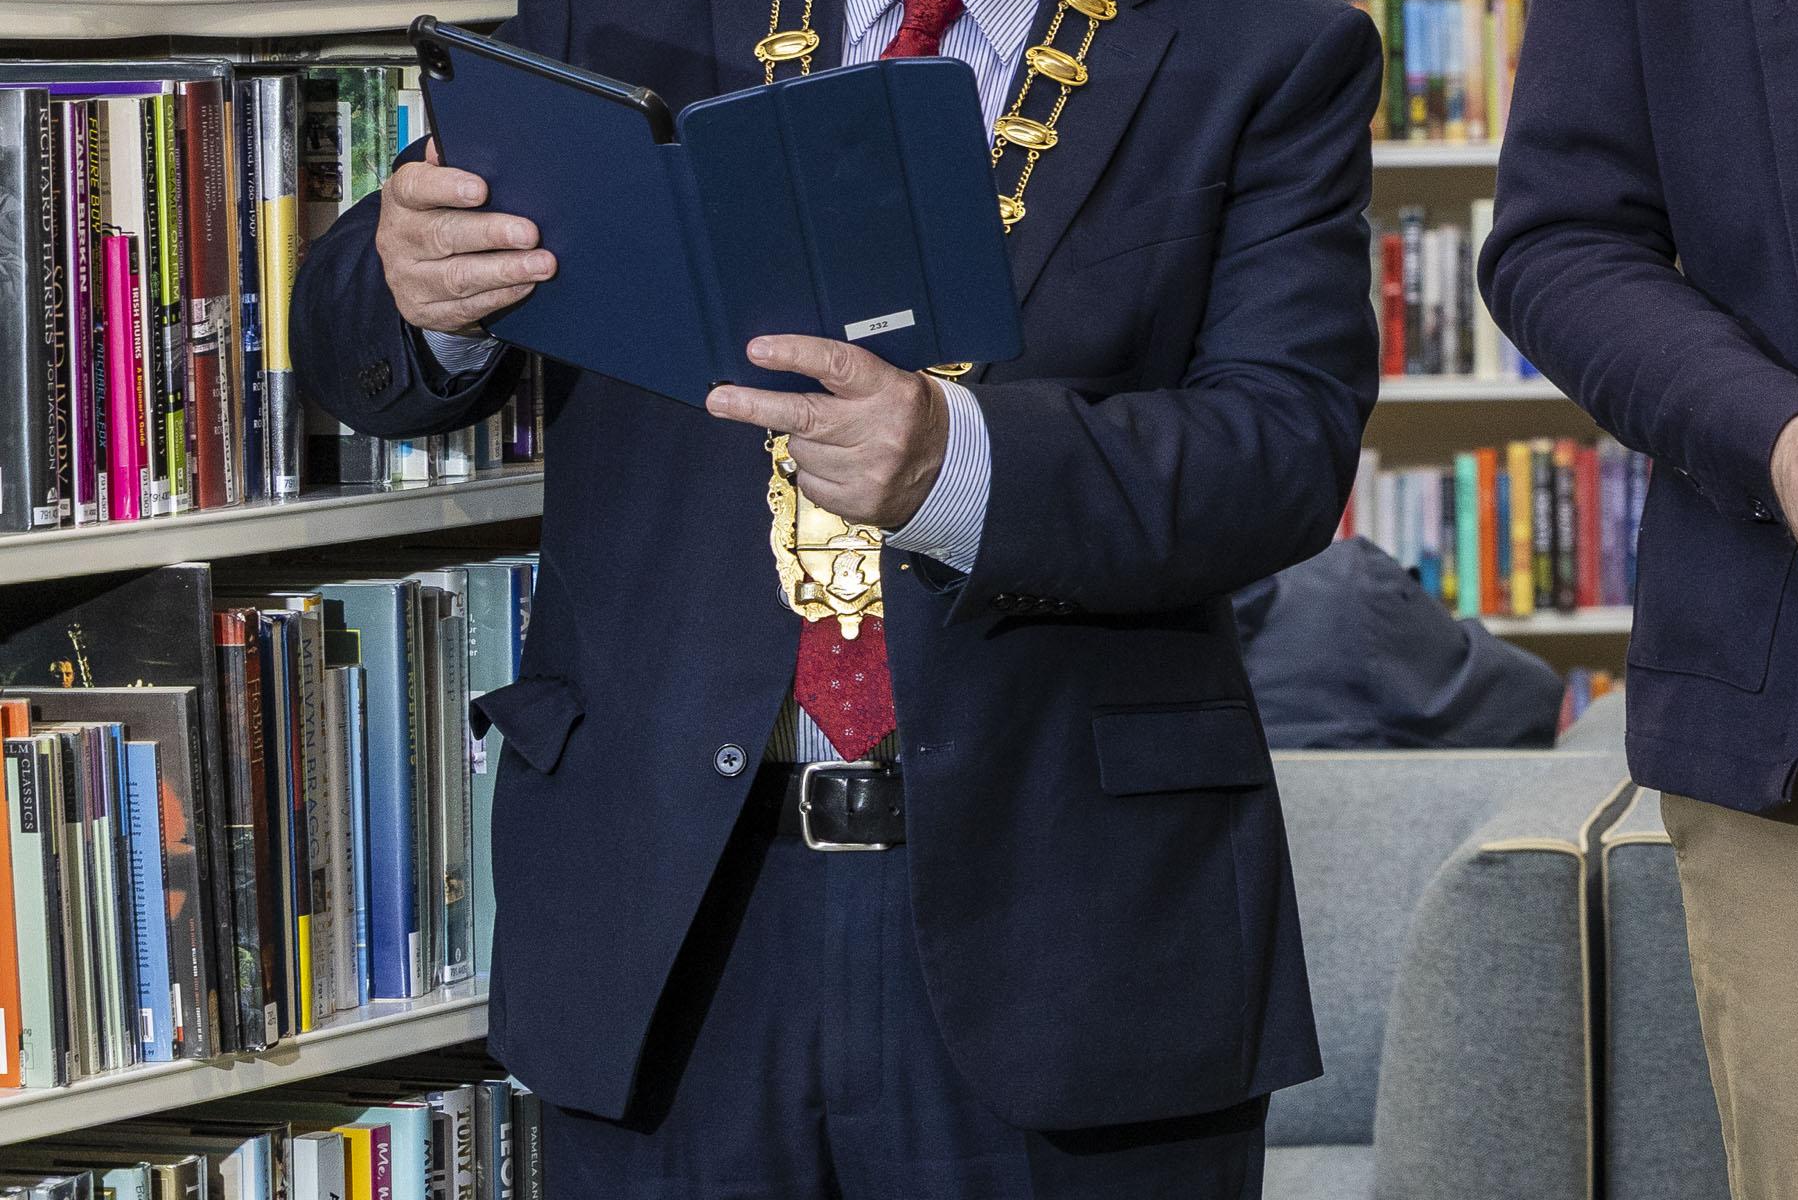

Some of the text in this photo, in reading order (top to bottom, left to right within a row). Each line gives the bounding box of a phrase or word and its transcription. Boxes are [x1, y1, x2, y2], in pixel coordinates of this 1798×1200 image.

[166, 103, 175, 163] GAELIC
[75, 108, 87, 293] JANE BIRKIN
[88, 117, 101, 233] FUTURE BOY
[171, 230, 178, 256] ON
[39, 108, 57, 470] RICHARD HARRIS JOE JACKSON
[131, 286, 142, 320] IRISH
[172, 261, 180, 301] FILM
[133, 321, 143, 360] HUNKS
[868, 319, 889, 332] 232
[138, 421, 147, 447] Guide
[301, 638, 321, 860] MELVYN BRAGG
[21, 758, 34, 830] CLASSICS
[456, 1106, 473, 1174] TONY
[530, 1125, 538, 1177] PAMELA
